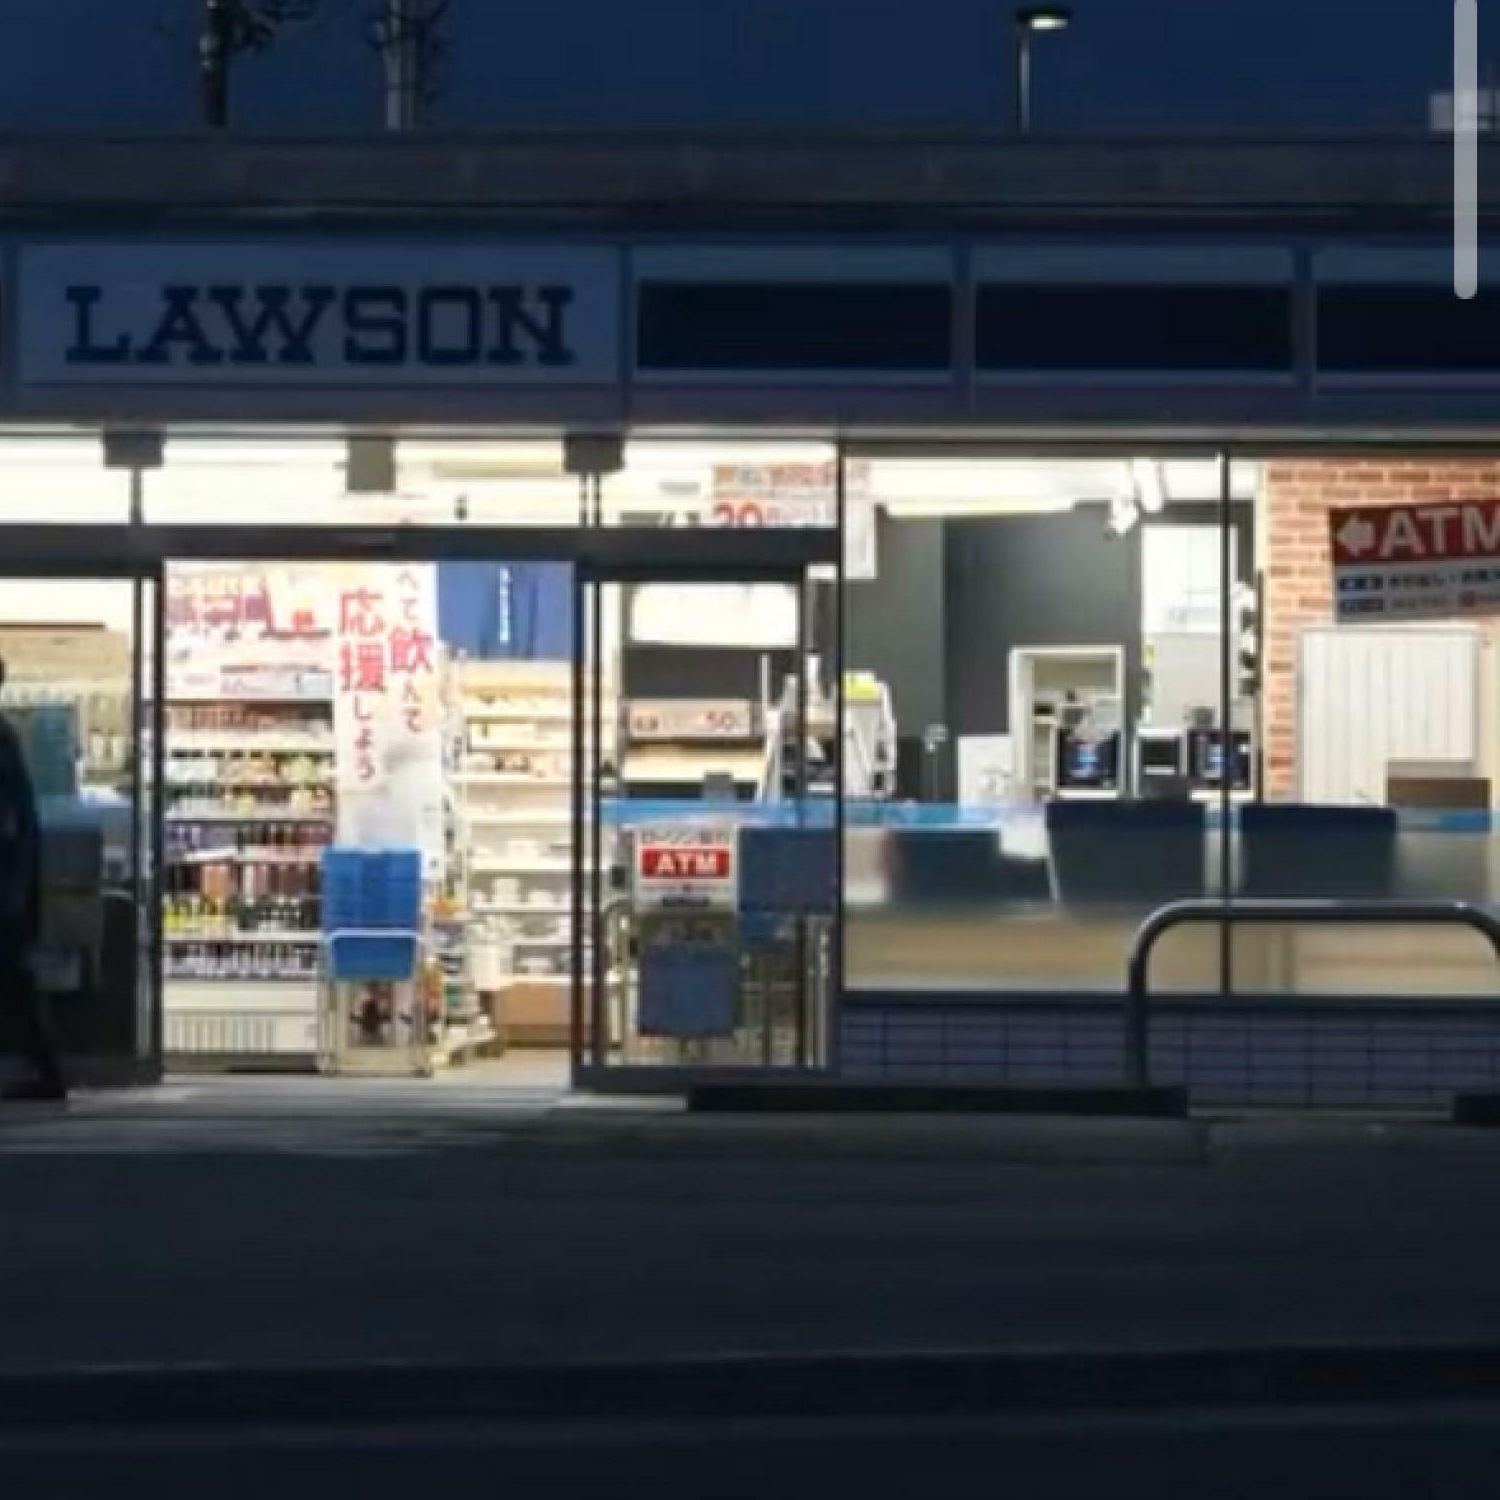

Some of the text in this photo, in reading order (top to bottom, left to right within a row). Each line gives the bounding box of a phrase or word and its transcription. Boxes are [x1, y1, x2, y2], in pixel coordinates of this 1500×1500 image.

[66, 285, 575, 366] LAWSON
[1378, 504, 1500, 557] ATM
[339, 585, 384, 782] 応援しよう
[657, 851, 717, 877] ATM
